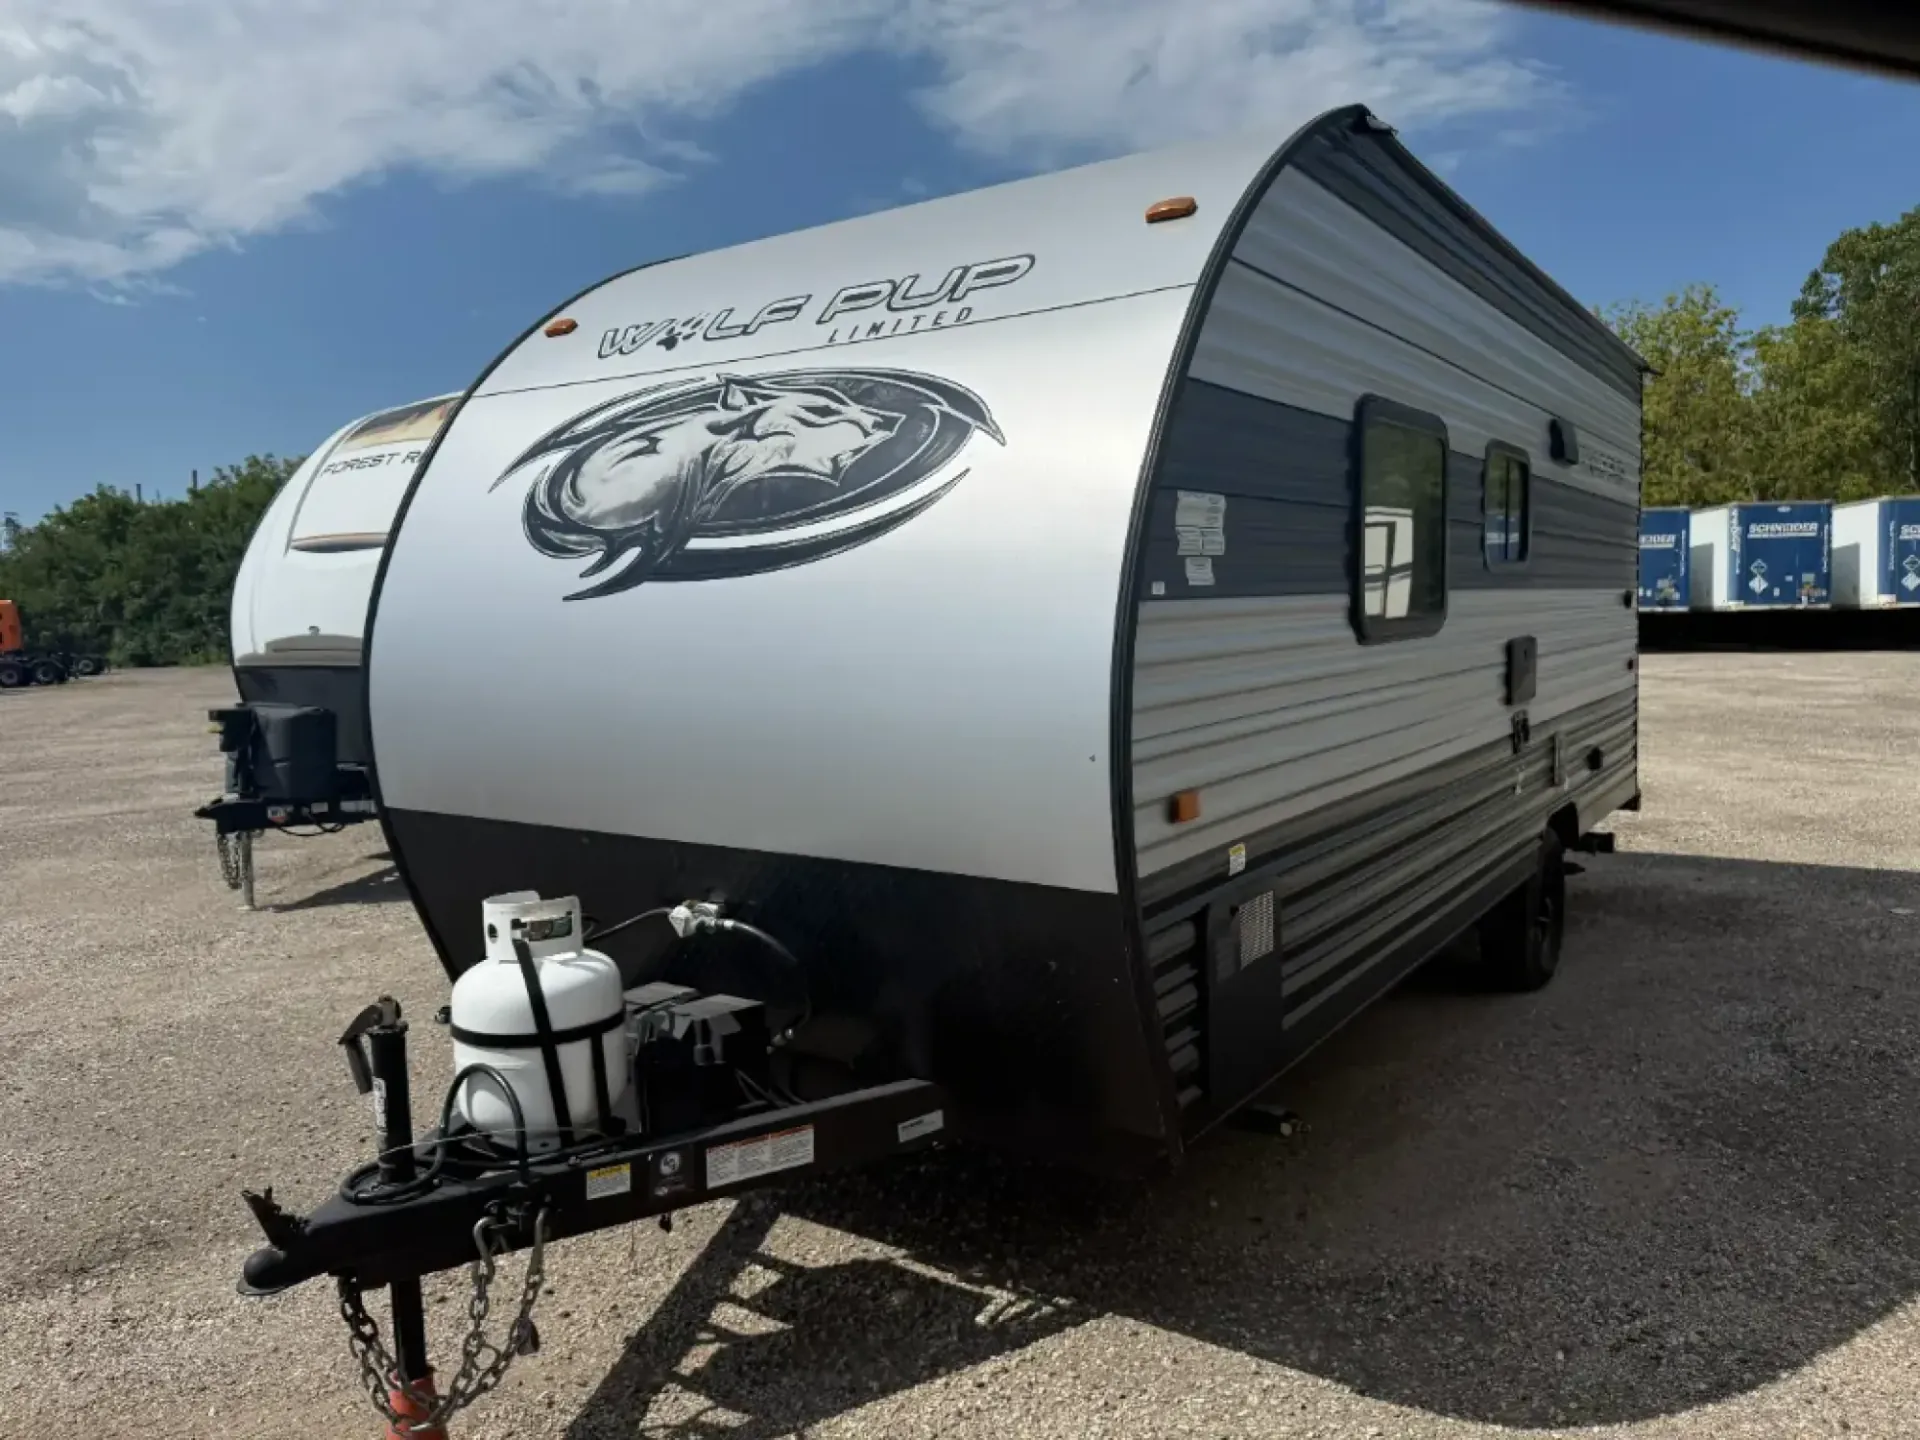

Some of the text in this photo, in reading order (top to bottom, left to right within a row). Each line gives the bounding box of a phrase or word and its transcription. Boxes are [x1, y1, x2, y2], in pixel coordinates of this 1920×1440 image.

[598, 253, 1036, 359] WOLF PUP
[828, 307, 973, 343] LIMITED
[322, 451, 421, 475] FOREST R
